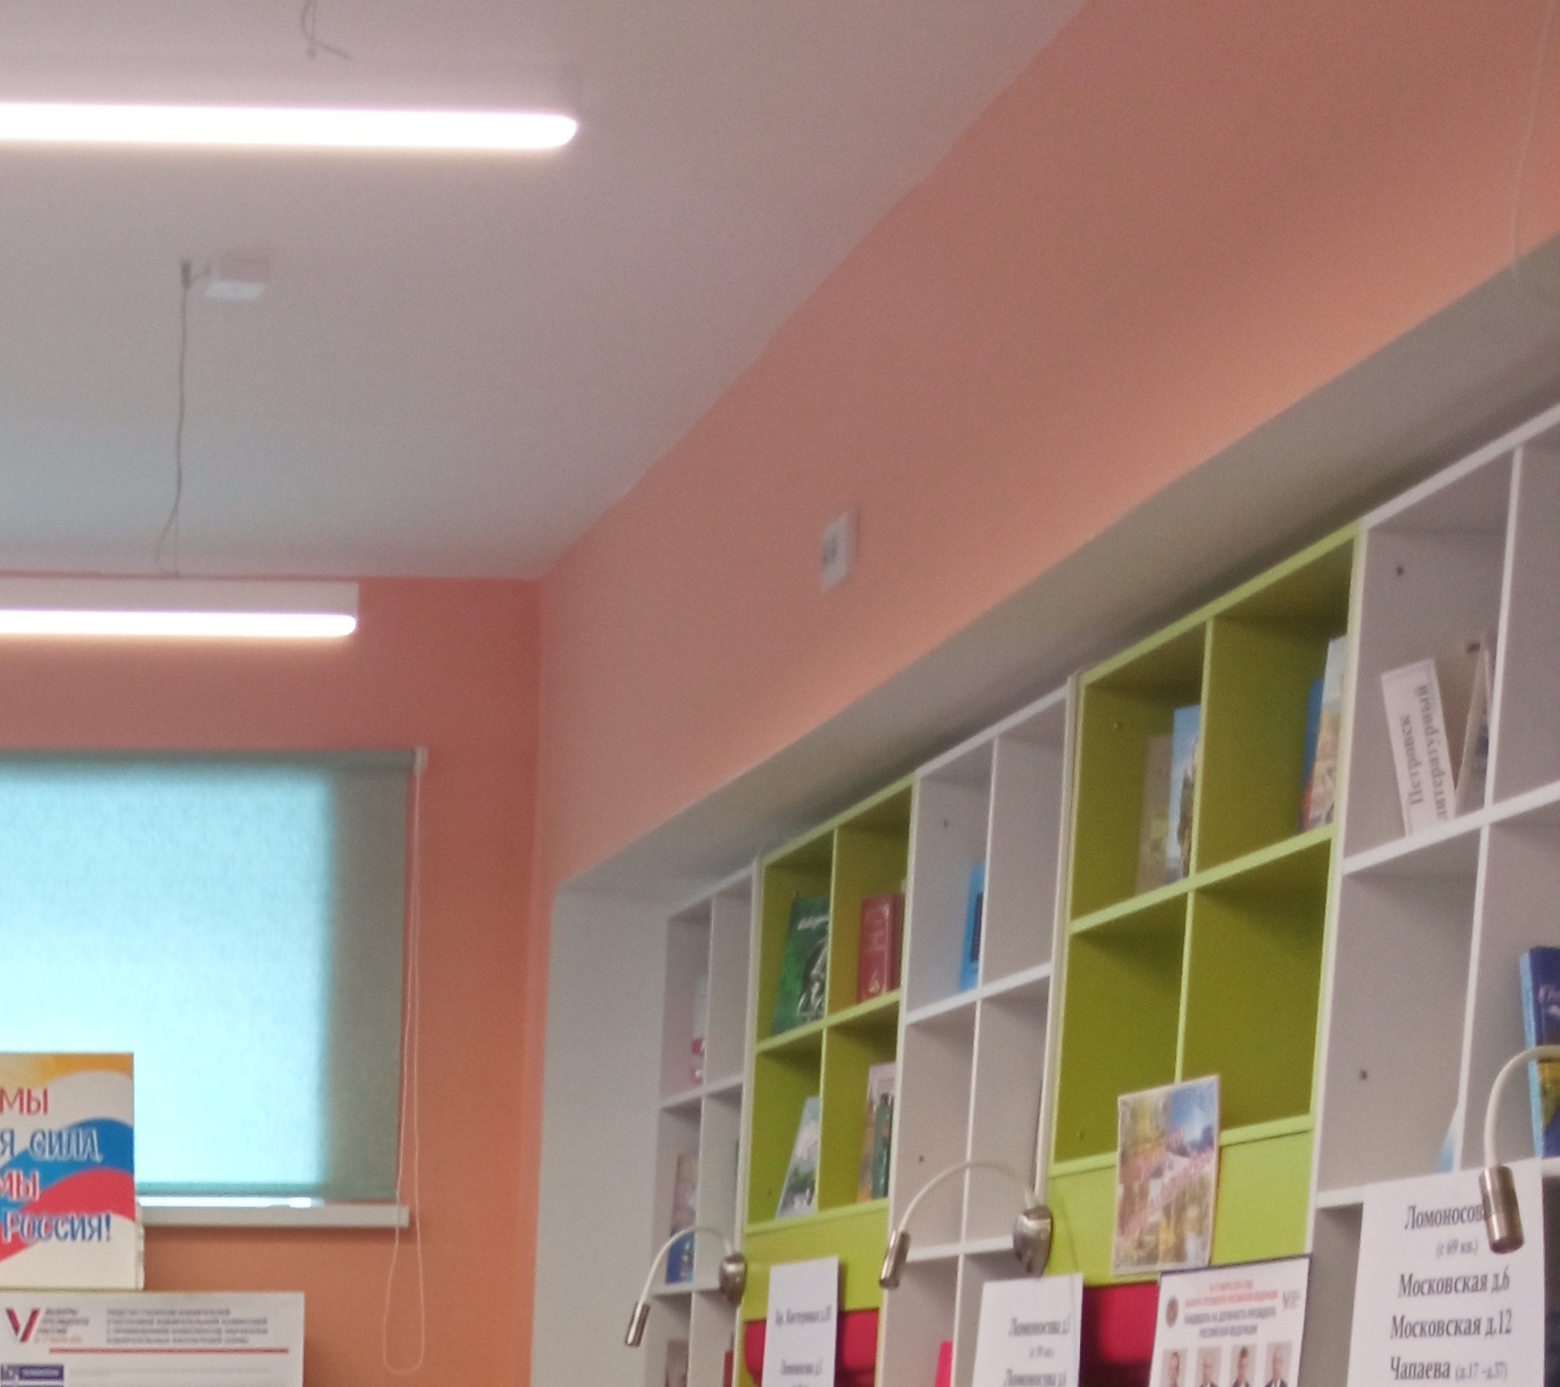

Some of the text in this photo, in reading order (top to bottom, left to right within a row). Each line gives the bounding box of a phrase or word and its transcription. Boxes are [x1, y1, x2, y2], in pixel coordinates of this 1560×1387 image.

[1399, 713, 1424, 805] Петровск
[1405, 1204, 1486, 1230] Ломоносов
[1398, 1266, 1510, 1299] Московская д.6
[1390, 1308, 1512, 1340] Московская д.12
[1390, 1356, 1450, 1380] Чапаева
